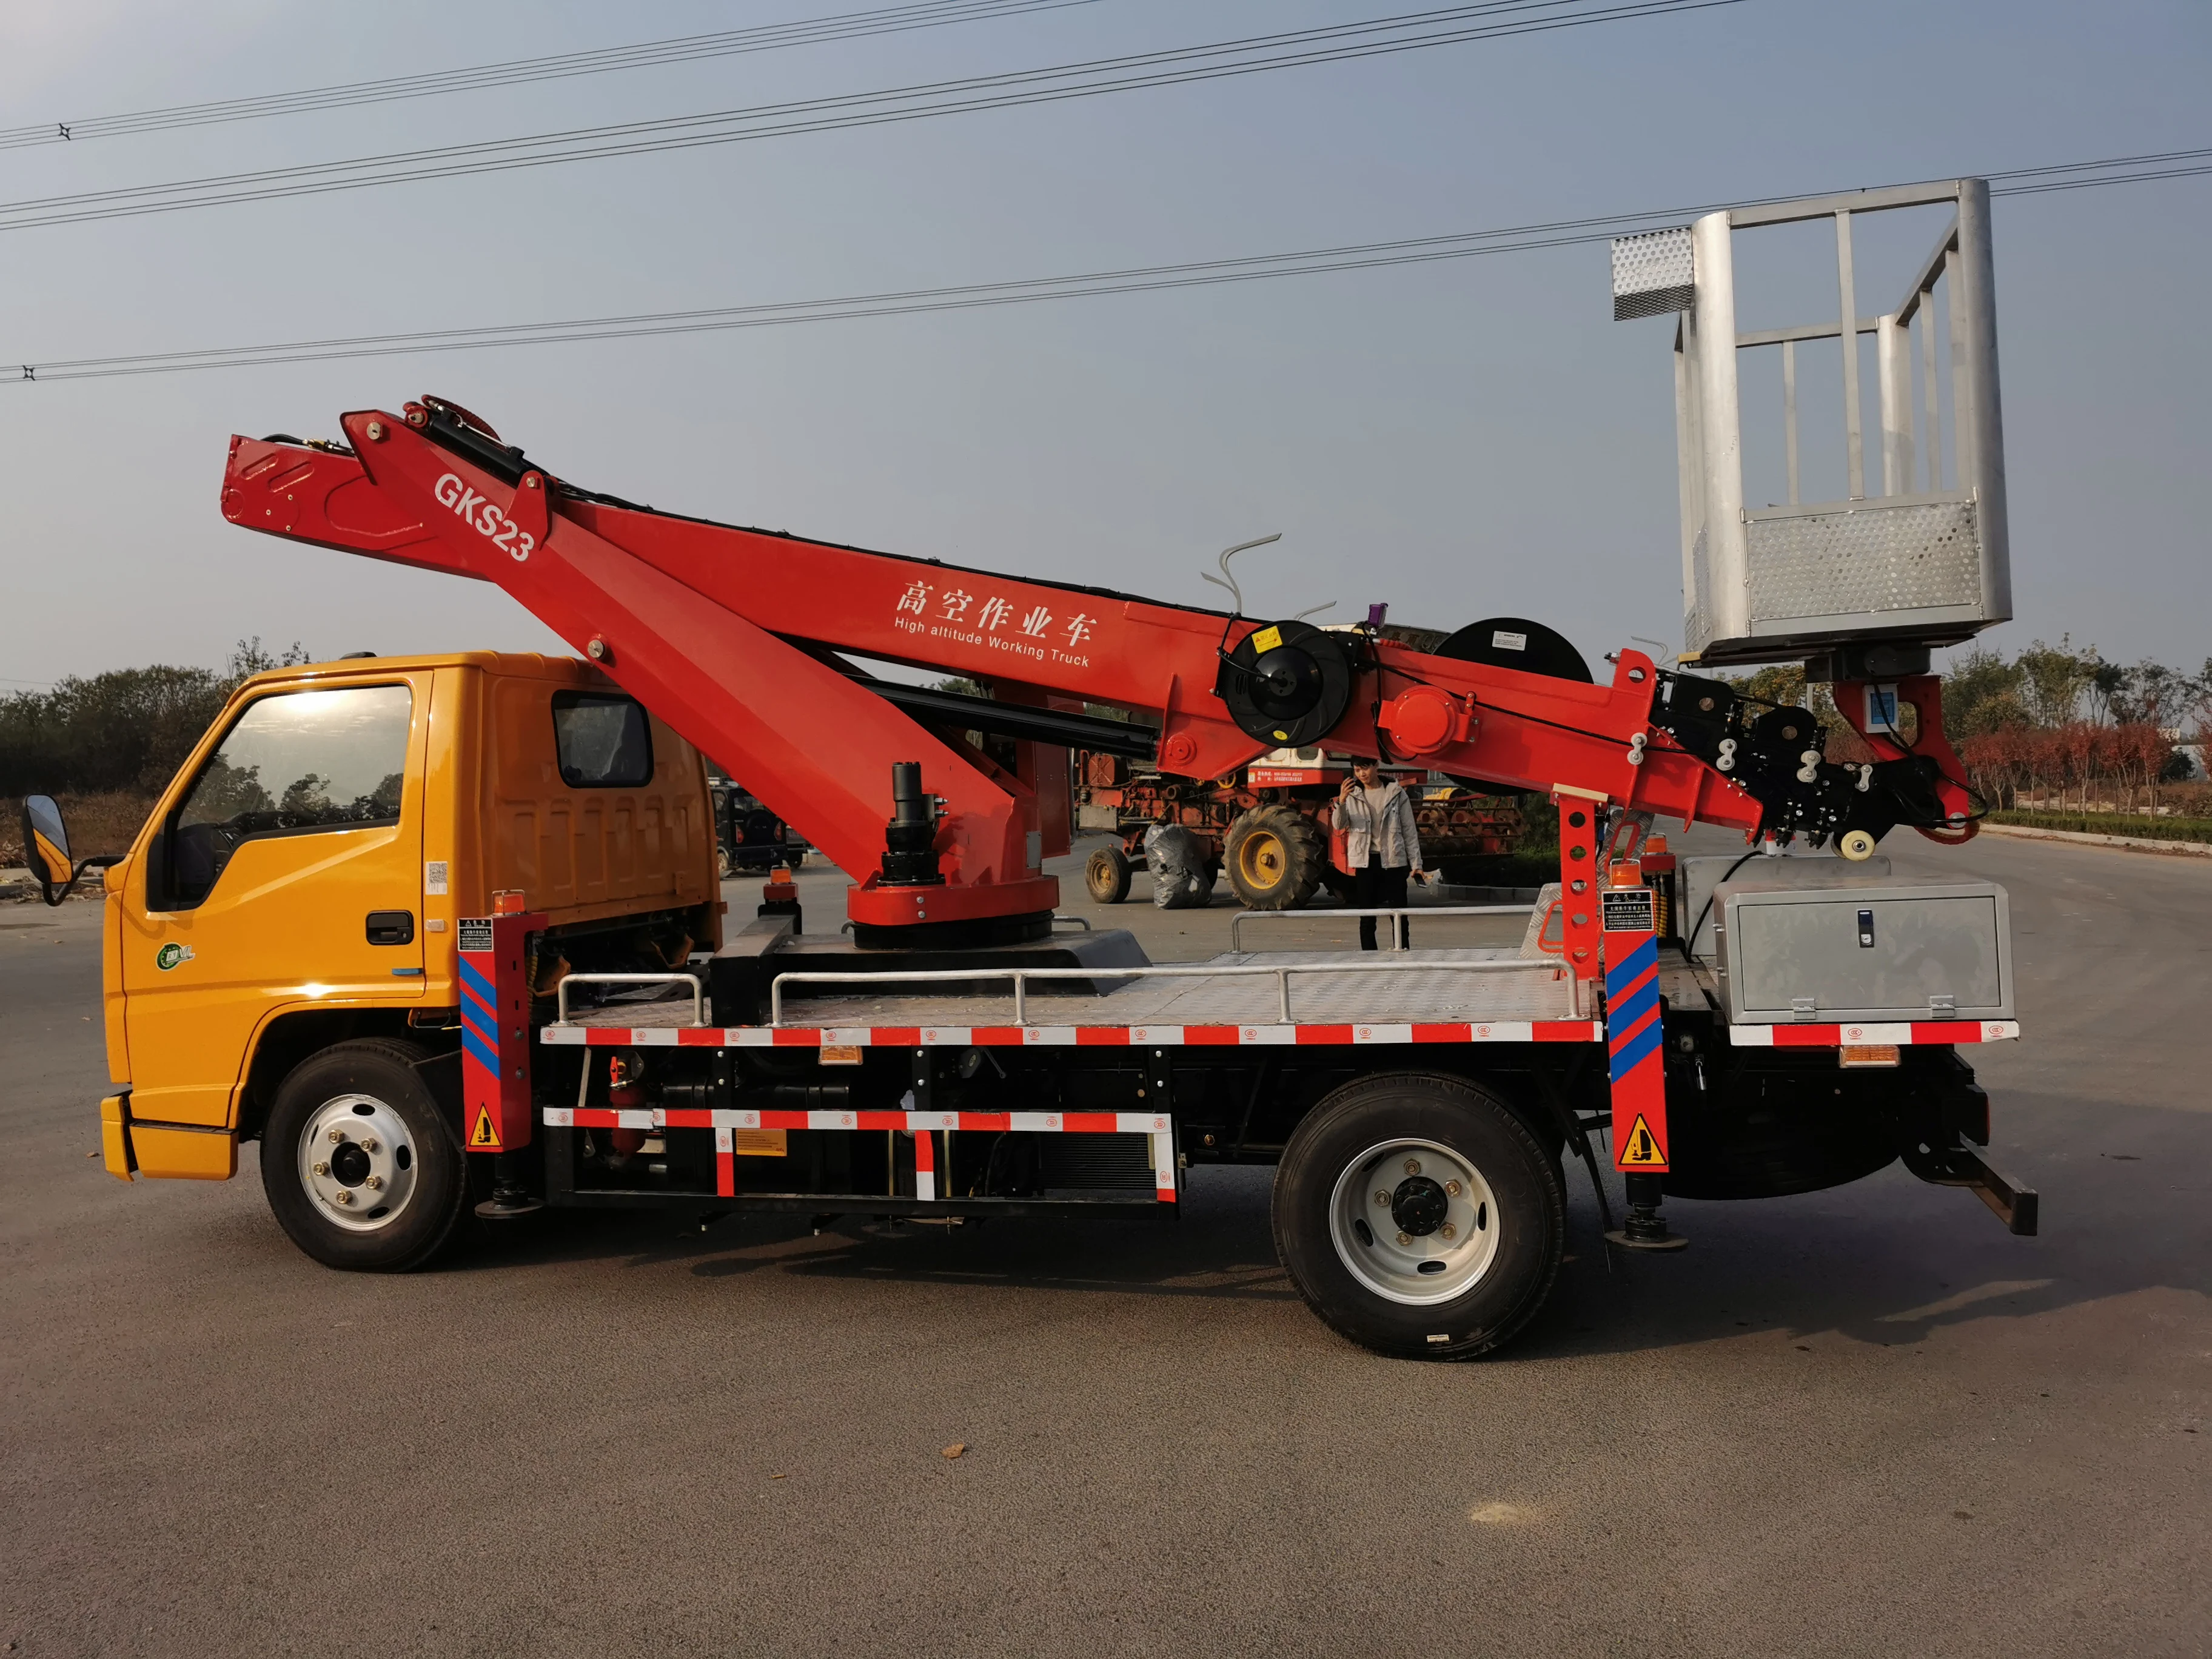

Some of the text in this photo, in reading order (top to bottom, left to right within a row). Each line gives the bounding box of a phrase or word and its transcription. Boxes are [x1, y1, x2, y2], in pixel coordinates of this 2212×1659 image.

[434, 473, 535, 562] GKS23
[894, 616, 1090, 668] High altitude Working Truck
[896, 580, 1098, 647] 高空作业车
